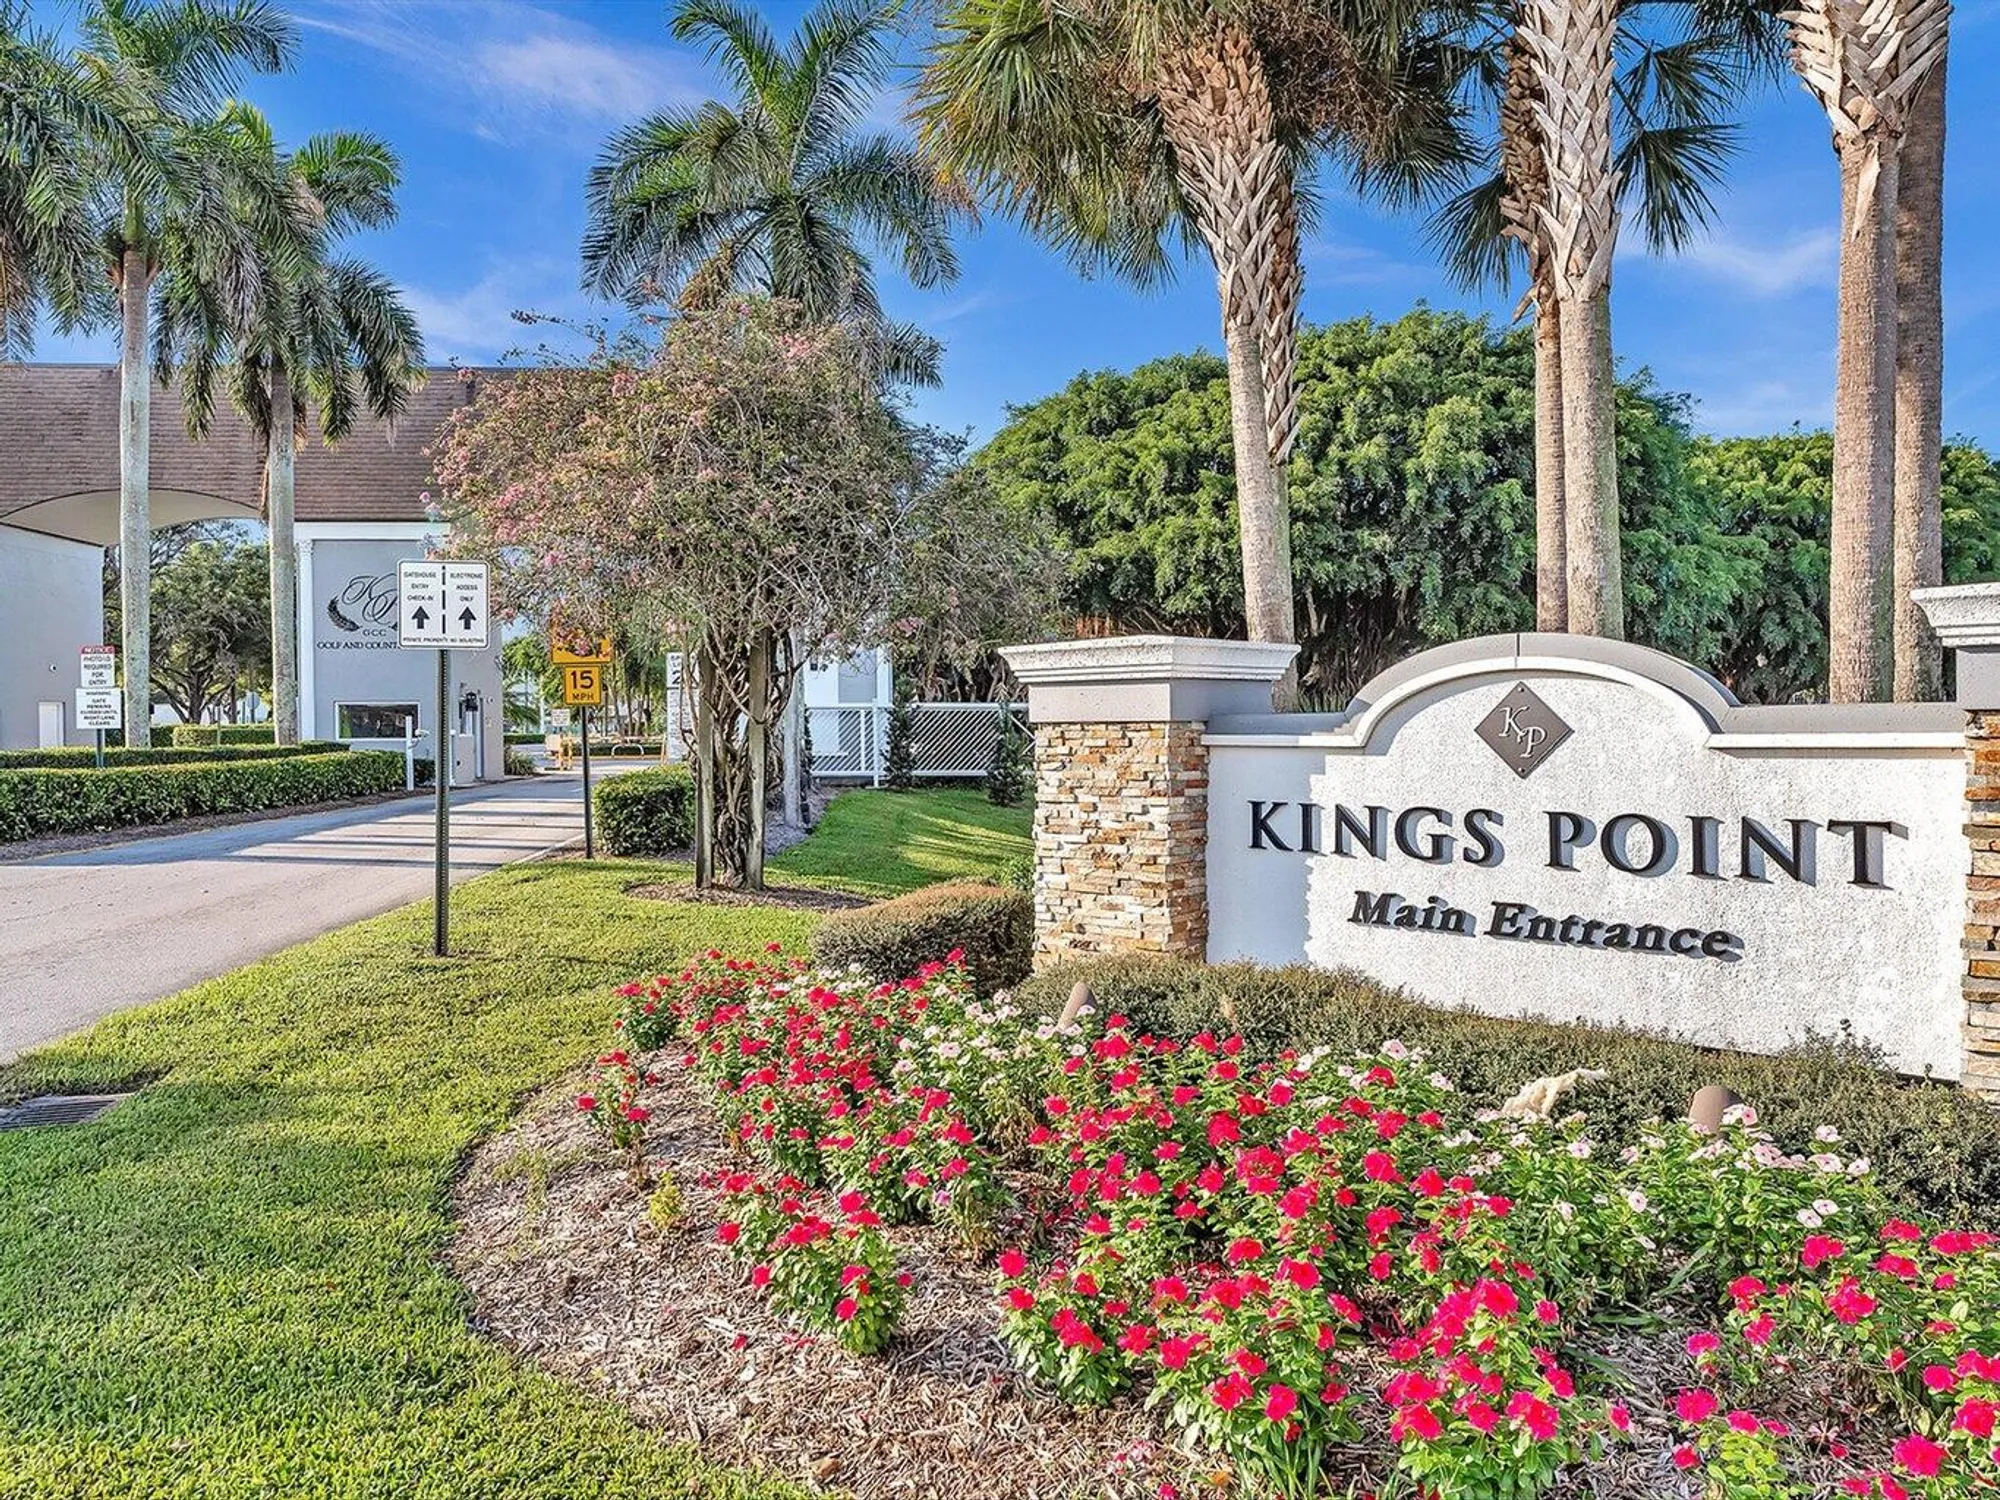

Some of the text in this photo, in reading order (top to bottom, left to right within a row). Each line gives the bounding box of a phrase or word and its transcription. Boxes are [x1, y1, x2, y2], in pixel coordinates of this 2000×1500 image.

[316, 641, 400, 650] GOLF AND COUNT
[571, 670, 594, 690] 15
[1247, 800, 1908, 889] KINGS POINT
[1347, 889, 1741, 961] Main Entrance
